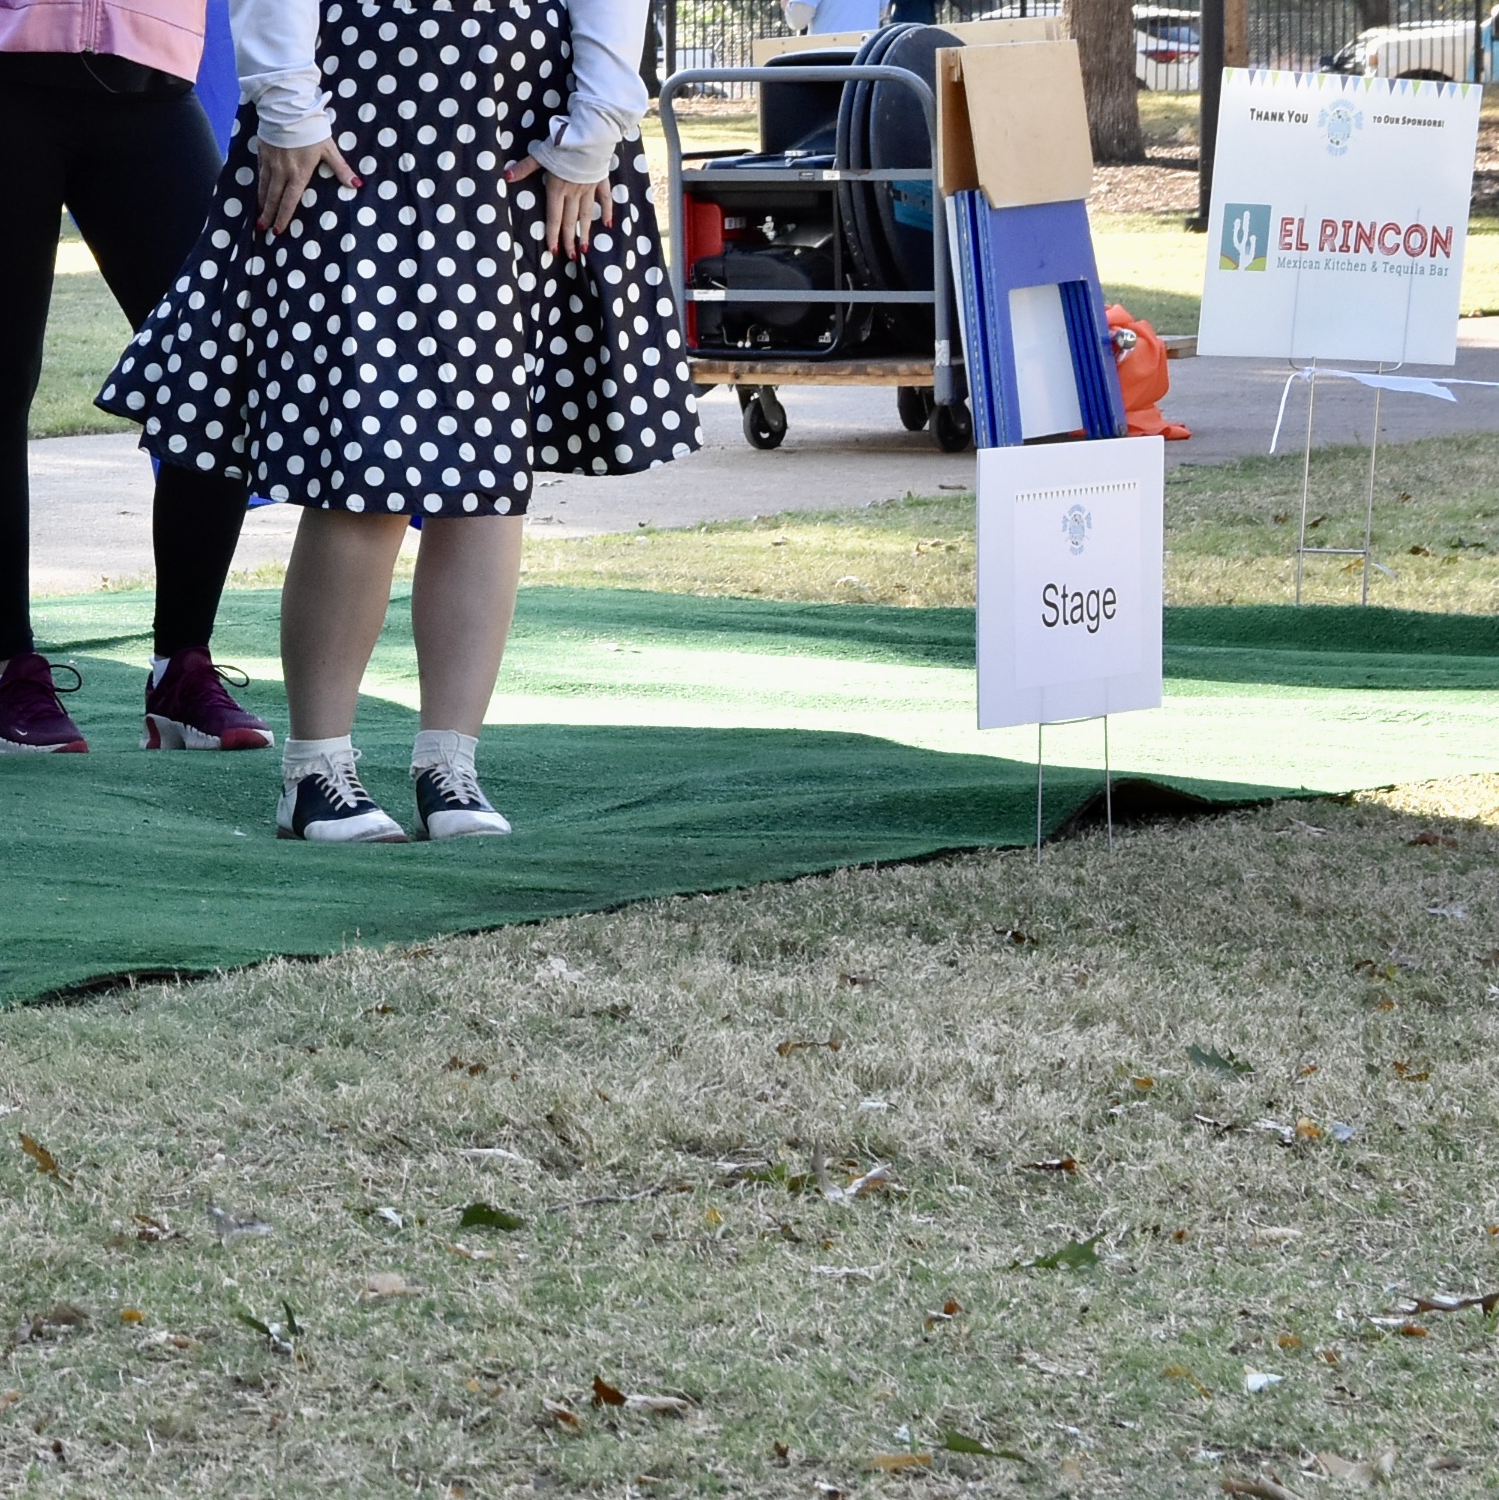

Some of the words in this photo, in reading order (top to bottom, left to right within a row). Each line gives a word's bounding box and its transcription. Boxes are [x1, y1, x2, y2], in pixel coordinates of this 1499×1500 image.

[1278, 216, 1309, 251] EL
[1318, 219, 1453, 259] RINCON
[1276, 257, 1320, 270] Mexican
[1323, 258, 1367, 272] Kitchen
[1370, 261, 1378, 272] &
[1382, 262, 1425, 276] Tequila
[1428, 264, 1449, 276] Bar
[1041, 583, 1116, 634] Stage
